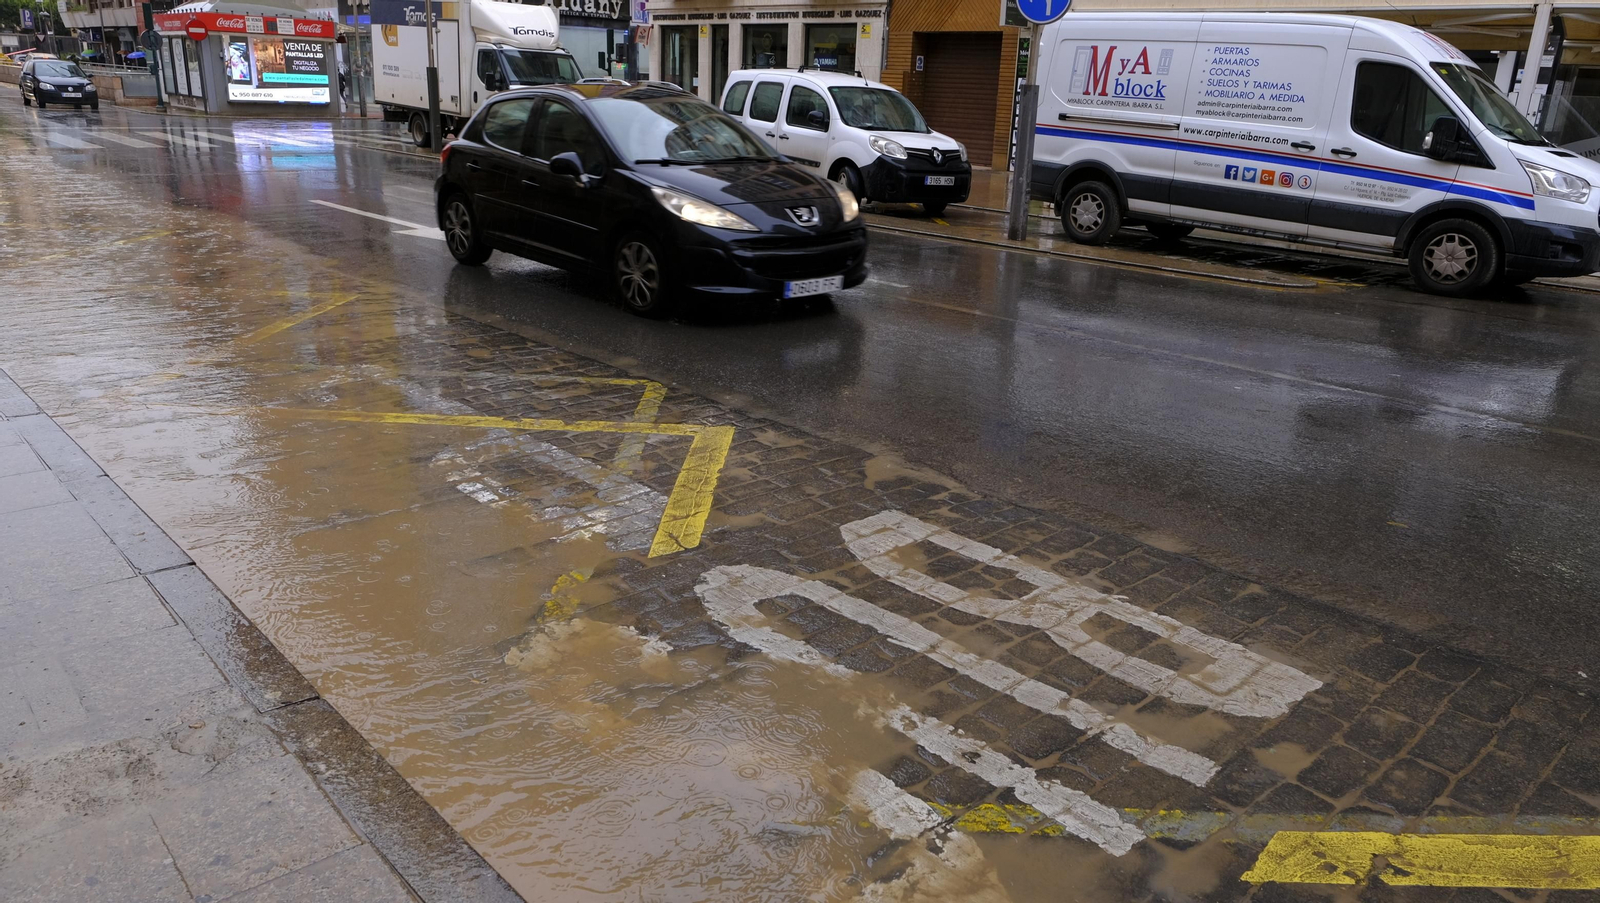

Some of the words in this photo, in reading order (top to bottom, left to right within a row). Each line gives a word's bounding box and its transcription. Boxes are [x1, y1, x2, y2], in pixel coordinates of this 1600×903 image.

[403, 6, 436, 22] Tamds
[840, 10, 852, 18] LUIS
[509, 26, 555, 38] Tamdis
[284, 42, 311, 51] VENTA
[312, 44, 322, 52] DE
[1213, 46, 1250, 56] PUERTAS
[1211, 57, 1260, 67] ARMARIOS
[1209, 67, 1251, 77] COCINAS
[1112, 77, 1167, 100] block
[1206, 78, 1239, 88] SUELOS
[1243, 80, 1249, 88] Y
[1252, 81, 1292, 91] TARIMAS
[1204, 89, 1255, 100] MOBILIARIO
[1268, 93, 1305, 103] MEDIDA
[1096, 99, 1130, 107] CARPINTERIA
[1197, 100, 1293, 112] admin@carpinteriaibarra.com
[1195, 109, 1303, 123] myablock@carpinteriaibarra.com
[1183, 126, 1289, 146] www.carpinteriaibarra.com
